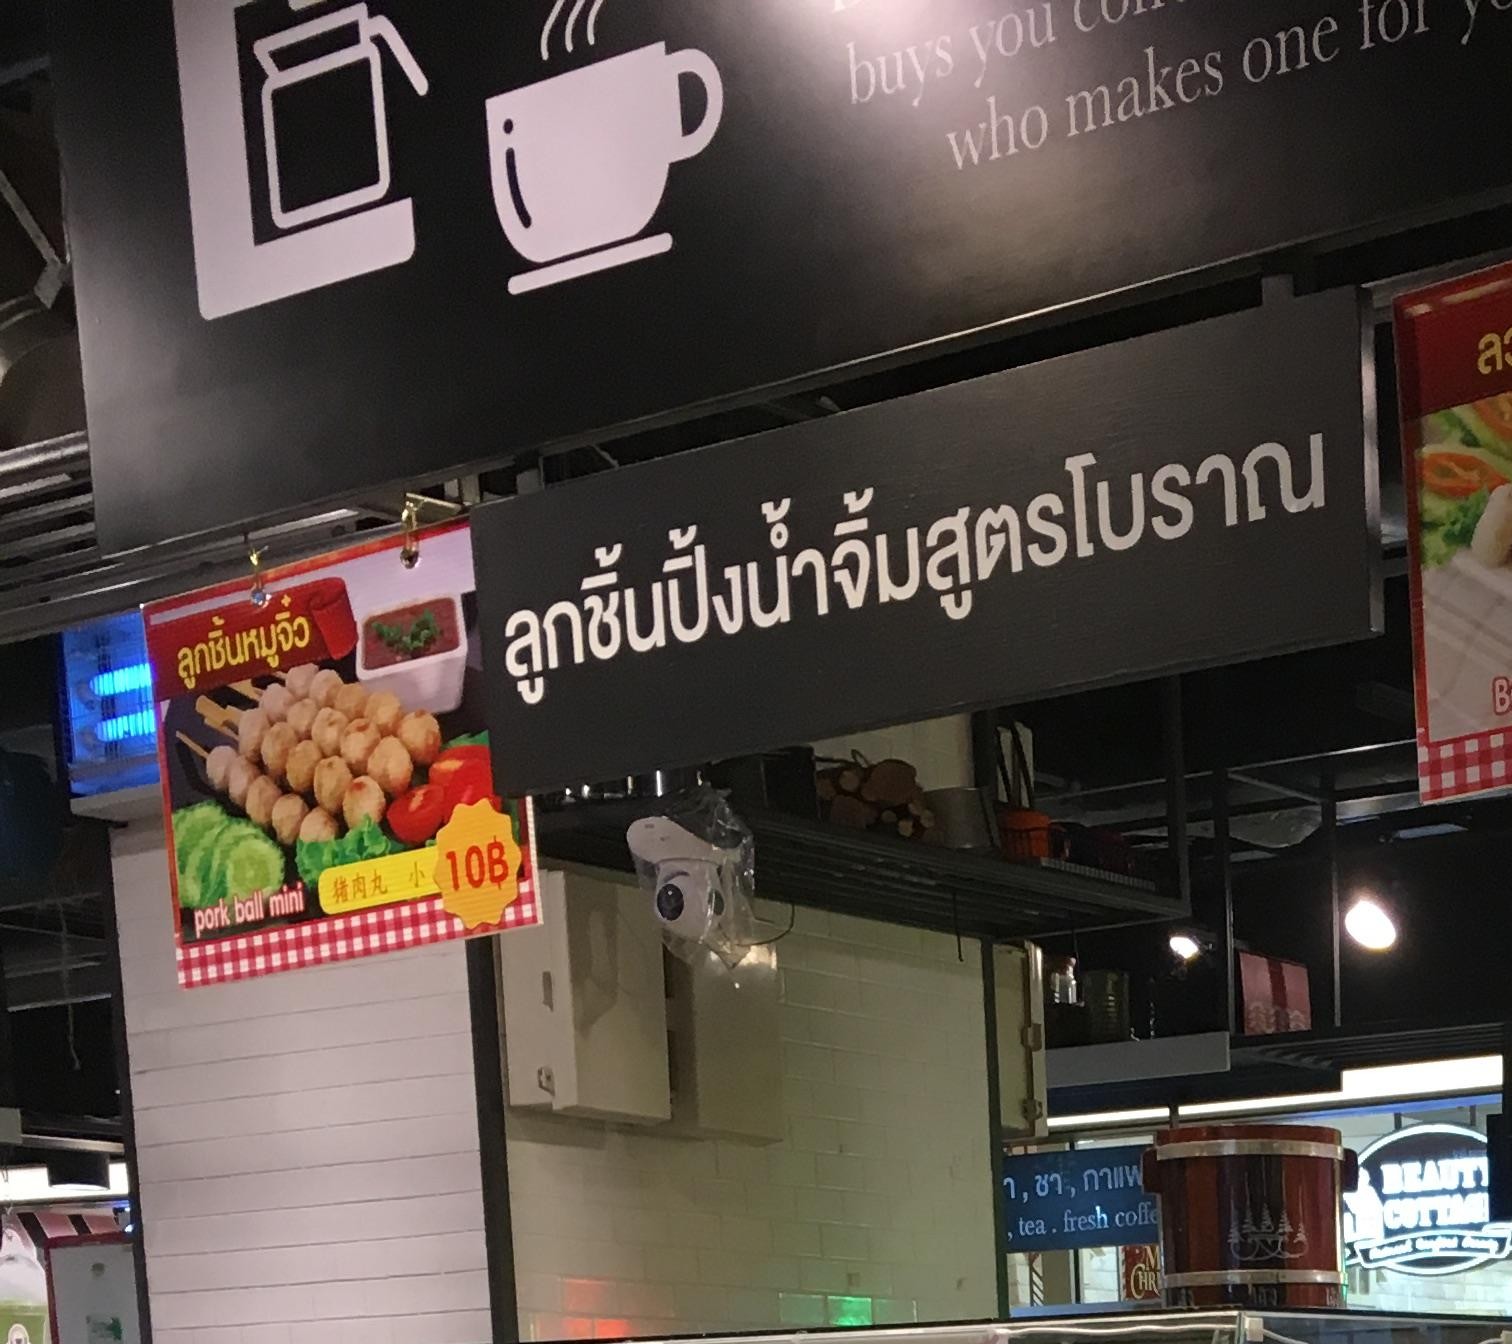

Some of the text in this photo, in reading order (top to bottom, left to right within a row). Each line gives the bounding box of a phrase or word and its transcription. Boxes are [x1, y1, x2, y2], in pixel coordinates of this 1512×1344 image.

[848, 33, 952, 106] buys
[971, 3, 1056, 88] you
[946, 98, 1049, 171] who
[1066, 47, 1224, 138] makes
[1241, 15, 1340, 83] one
[1359, 0, 1431, 50] for
[503, 430, 1327, 705] ลูกชิ้นปิ้งน้ำจิ้มสูตรโบราณ
[177, 594, 311, 690] ลูกชิ้นหมูจิ๋ว
[193, 884, 306, 940] pork ball mini
[331, 862, 428, 904] 猪肉丸 小
[1064, 1205, 1110, 1233] fresh
